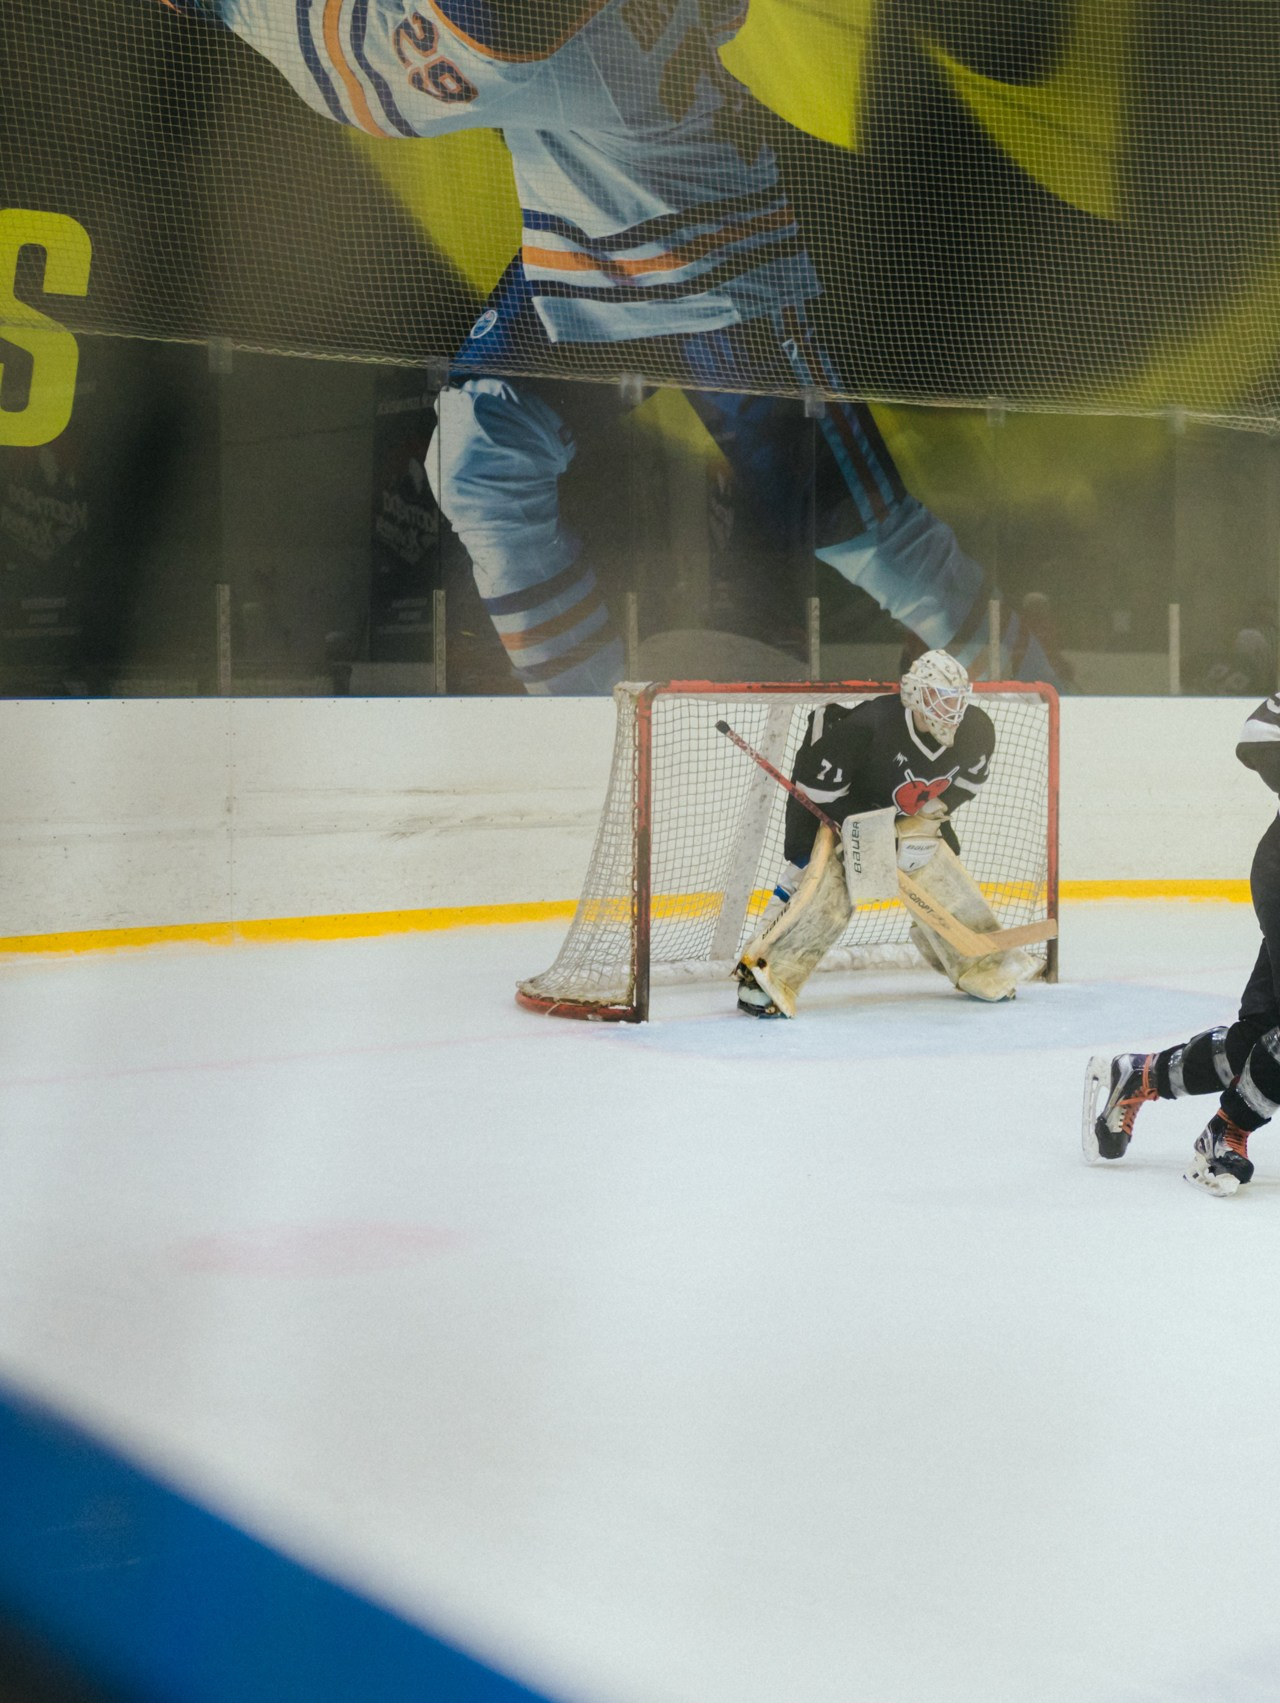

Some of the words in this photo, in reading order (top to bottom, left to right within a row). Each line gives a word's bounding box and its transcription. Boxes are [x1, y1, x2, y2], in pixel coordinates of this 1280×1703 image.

[392, 12, 478, 104] 29
[0, 208, 92, 447] S
[816, 758, 843, 783] 71
